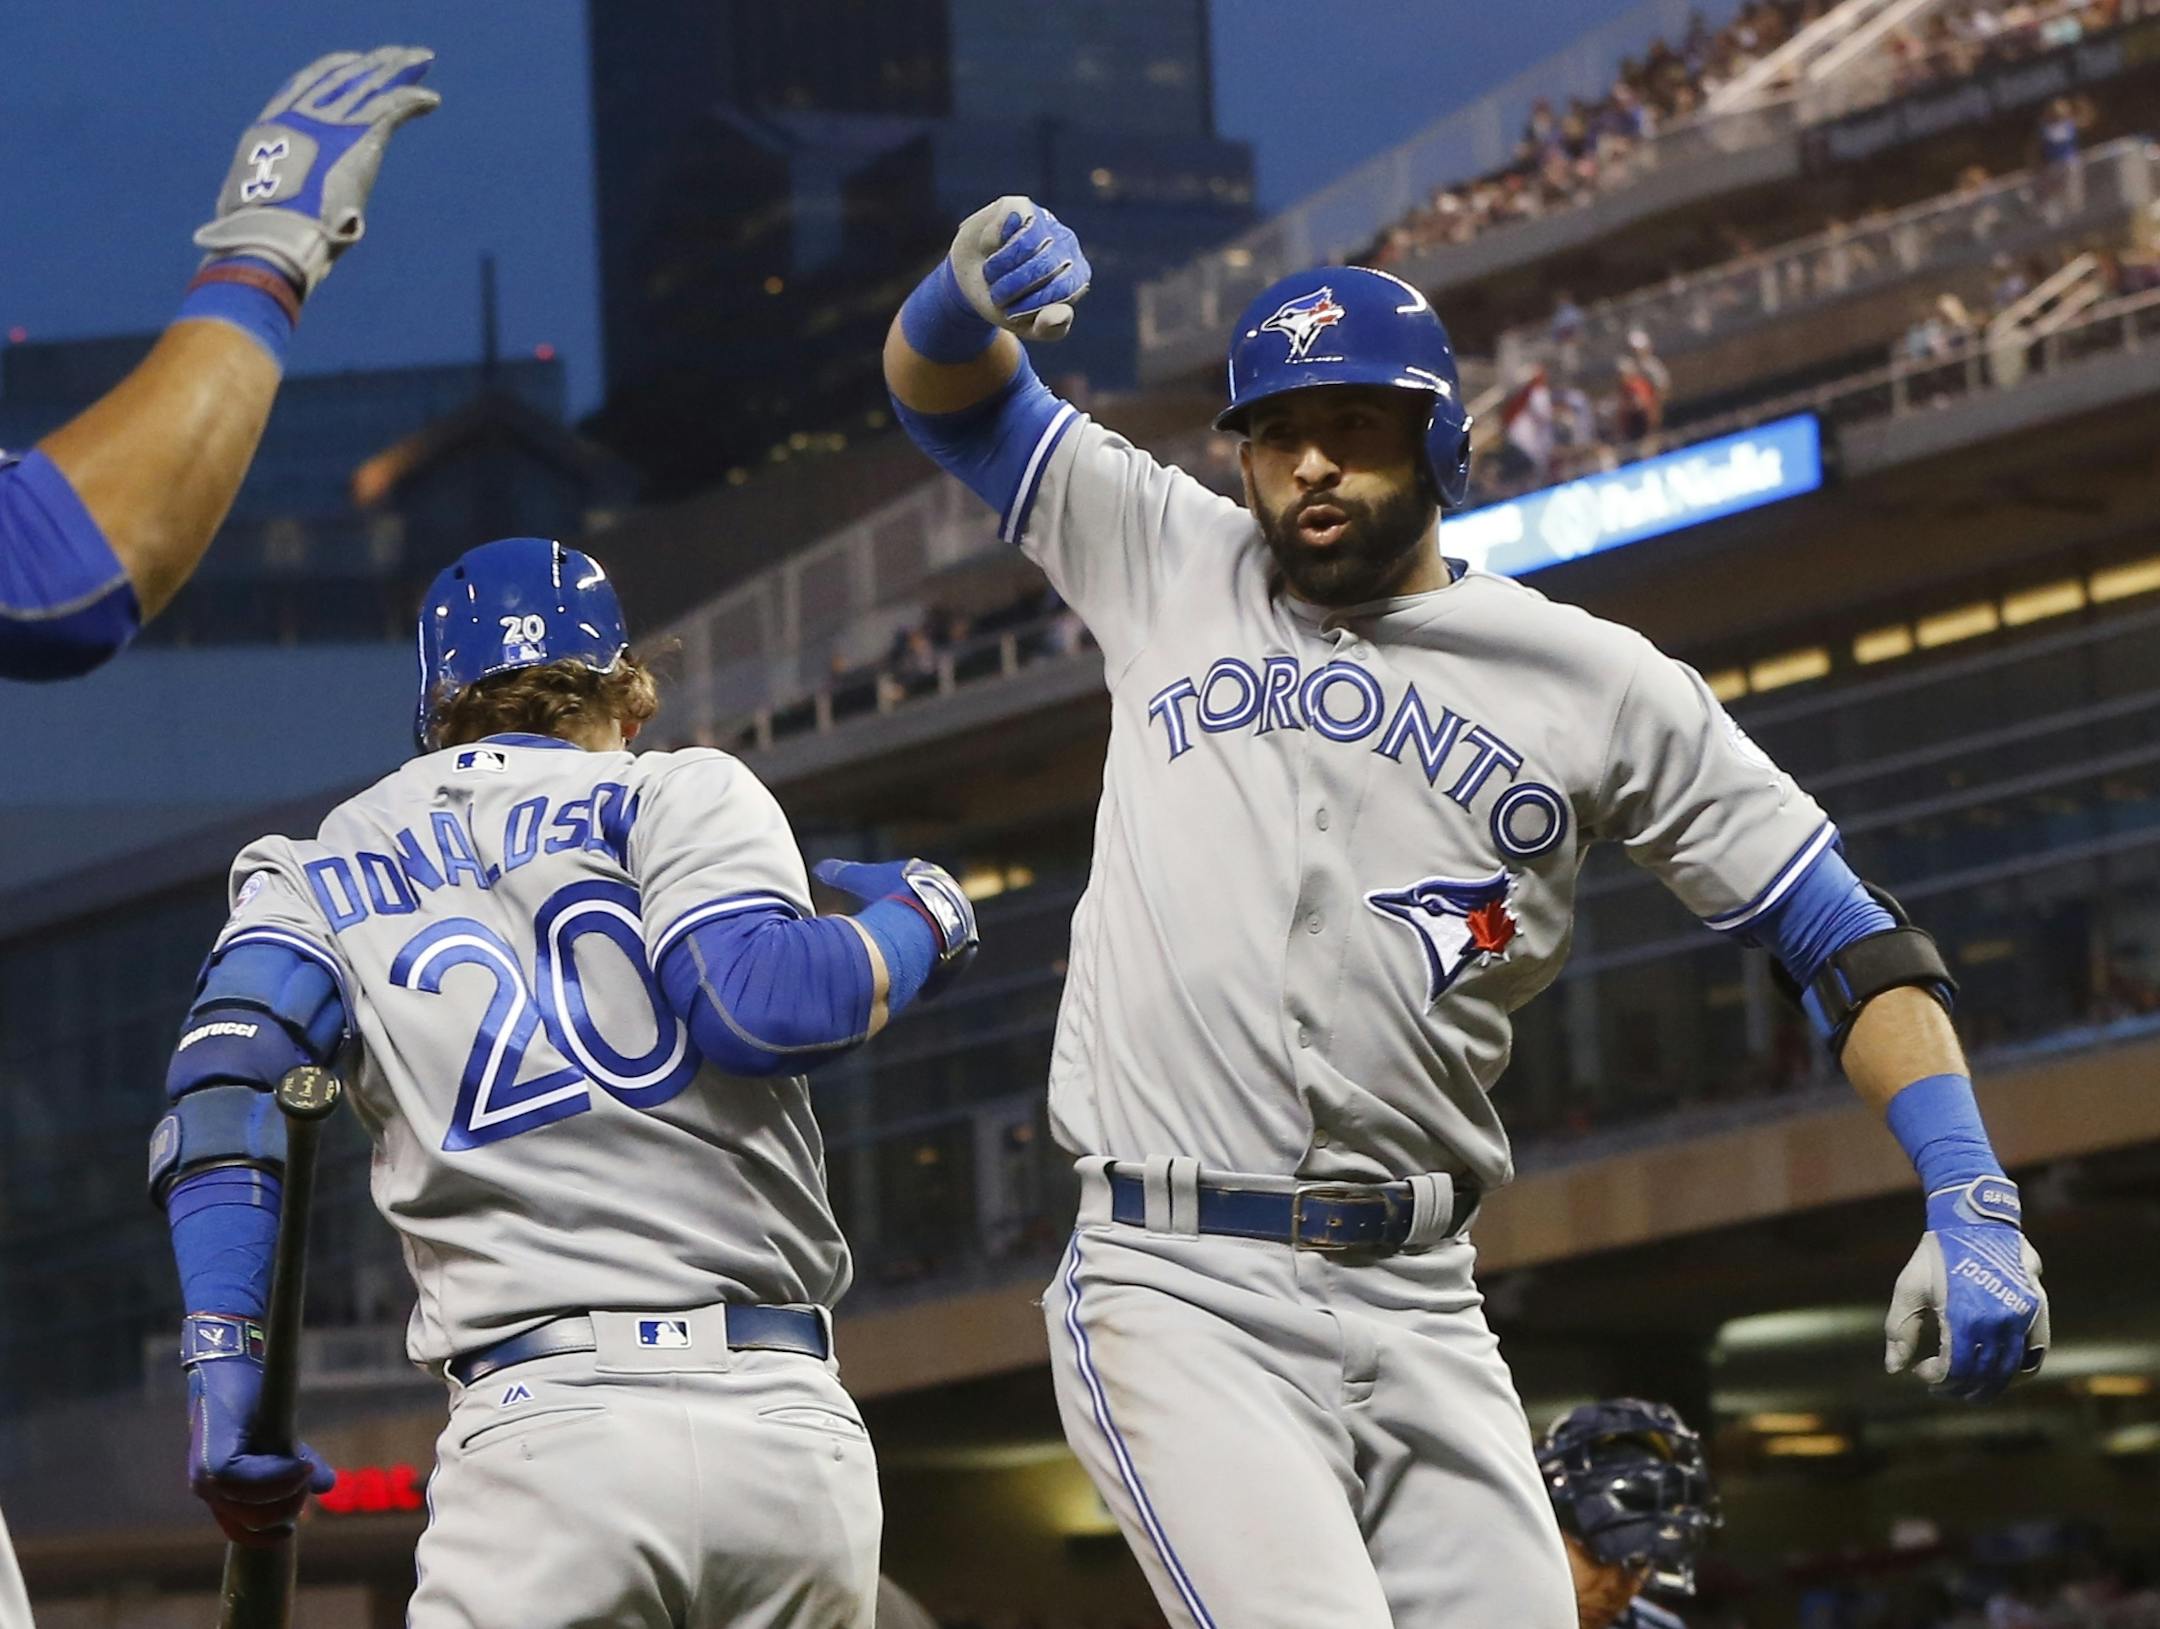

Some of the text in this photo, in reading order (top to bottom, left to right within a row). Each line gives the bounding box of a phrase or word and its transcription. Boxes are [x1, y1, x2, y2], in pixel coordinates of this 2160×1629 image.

[499, 613, 546, 645] 20
[1149, 656, 1568, 860] TORONTO
[389, 878, 702, 1151] 20
[1950, 1257, 2031, 1316] marucci
